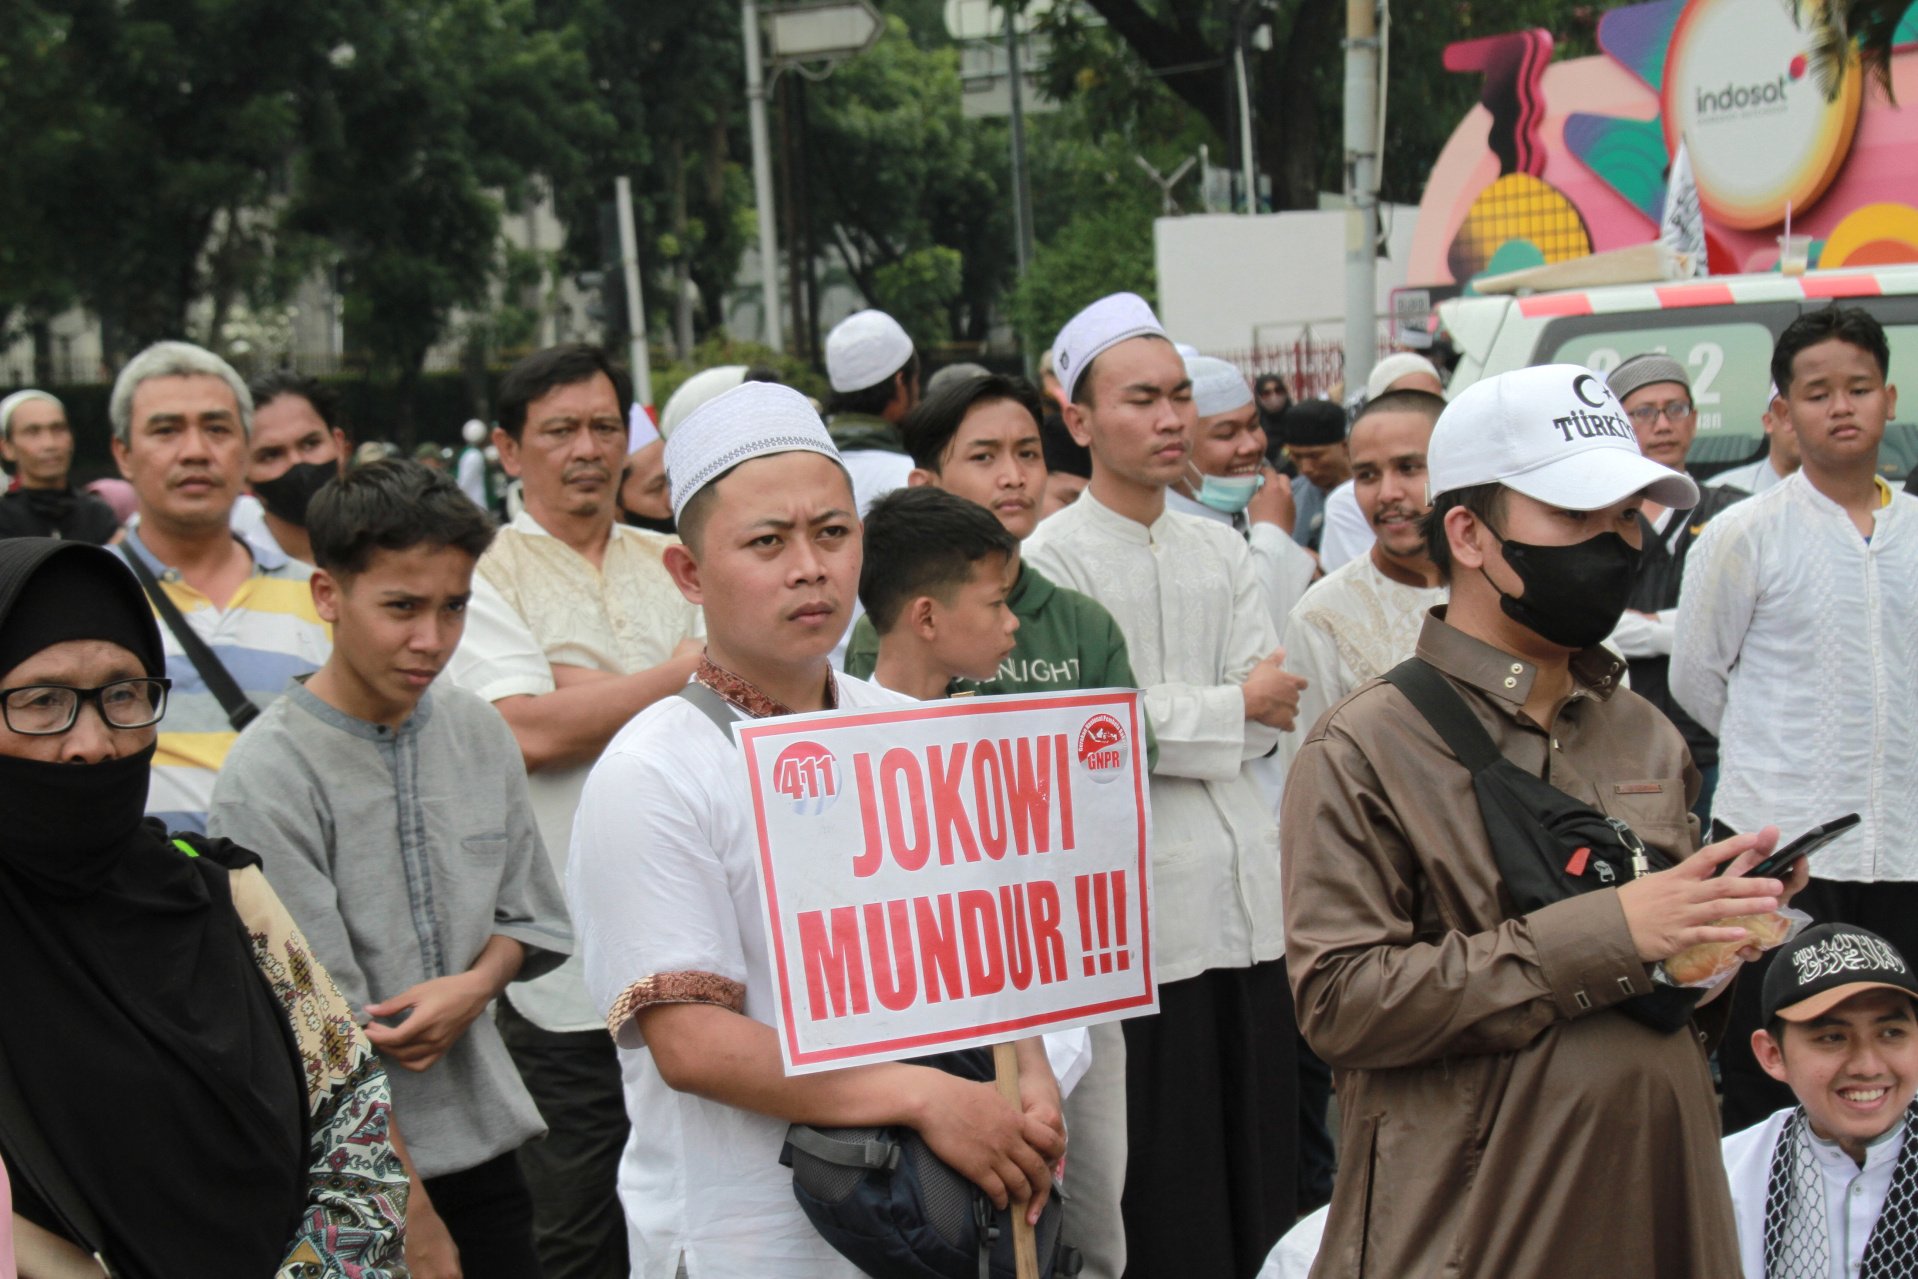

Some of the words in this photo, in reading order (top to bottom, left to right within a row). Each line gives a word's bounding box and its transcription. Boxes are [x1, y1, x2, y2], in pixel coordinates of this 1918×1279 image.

[780, 754, 836, 800] 411
[852, 733, 1075, 878] JOKOWI
[1087, 750, 1120, 770] GNPR
[797, 880, 1068, 1022] MUNDUR
[1074, 869, 1130, 977] !!!
